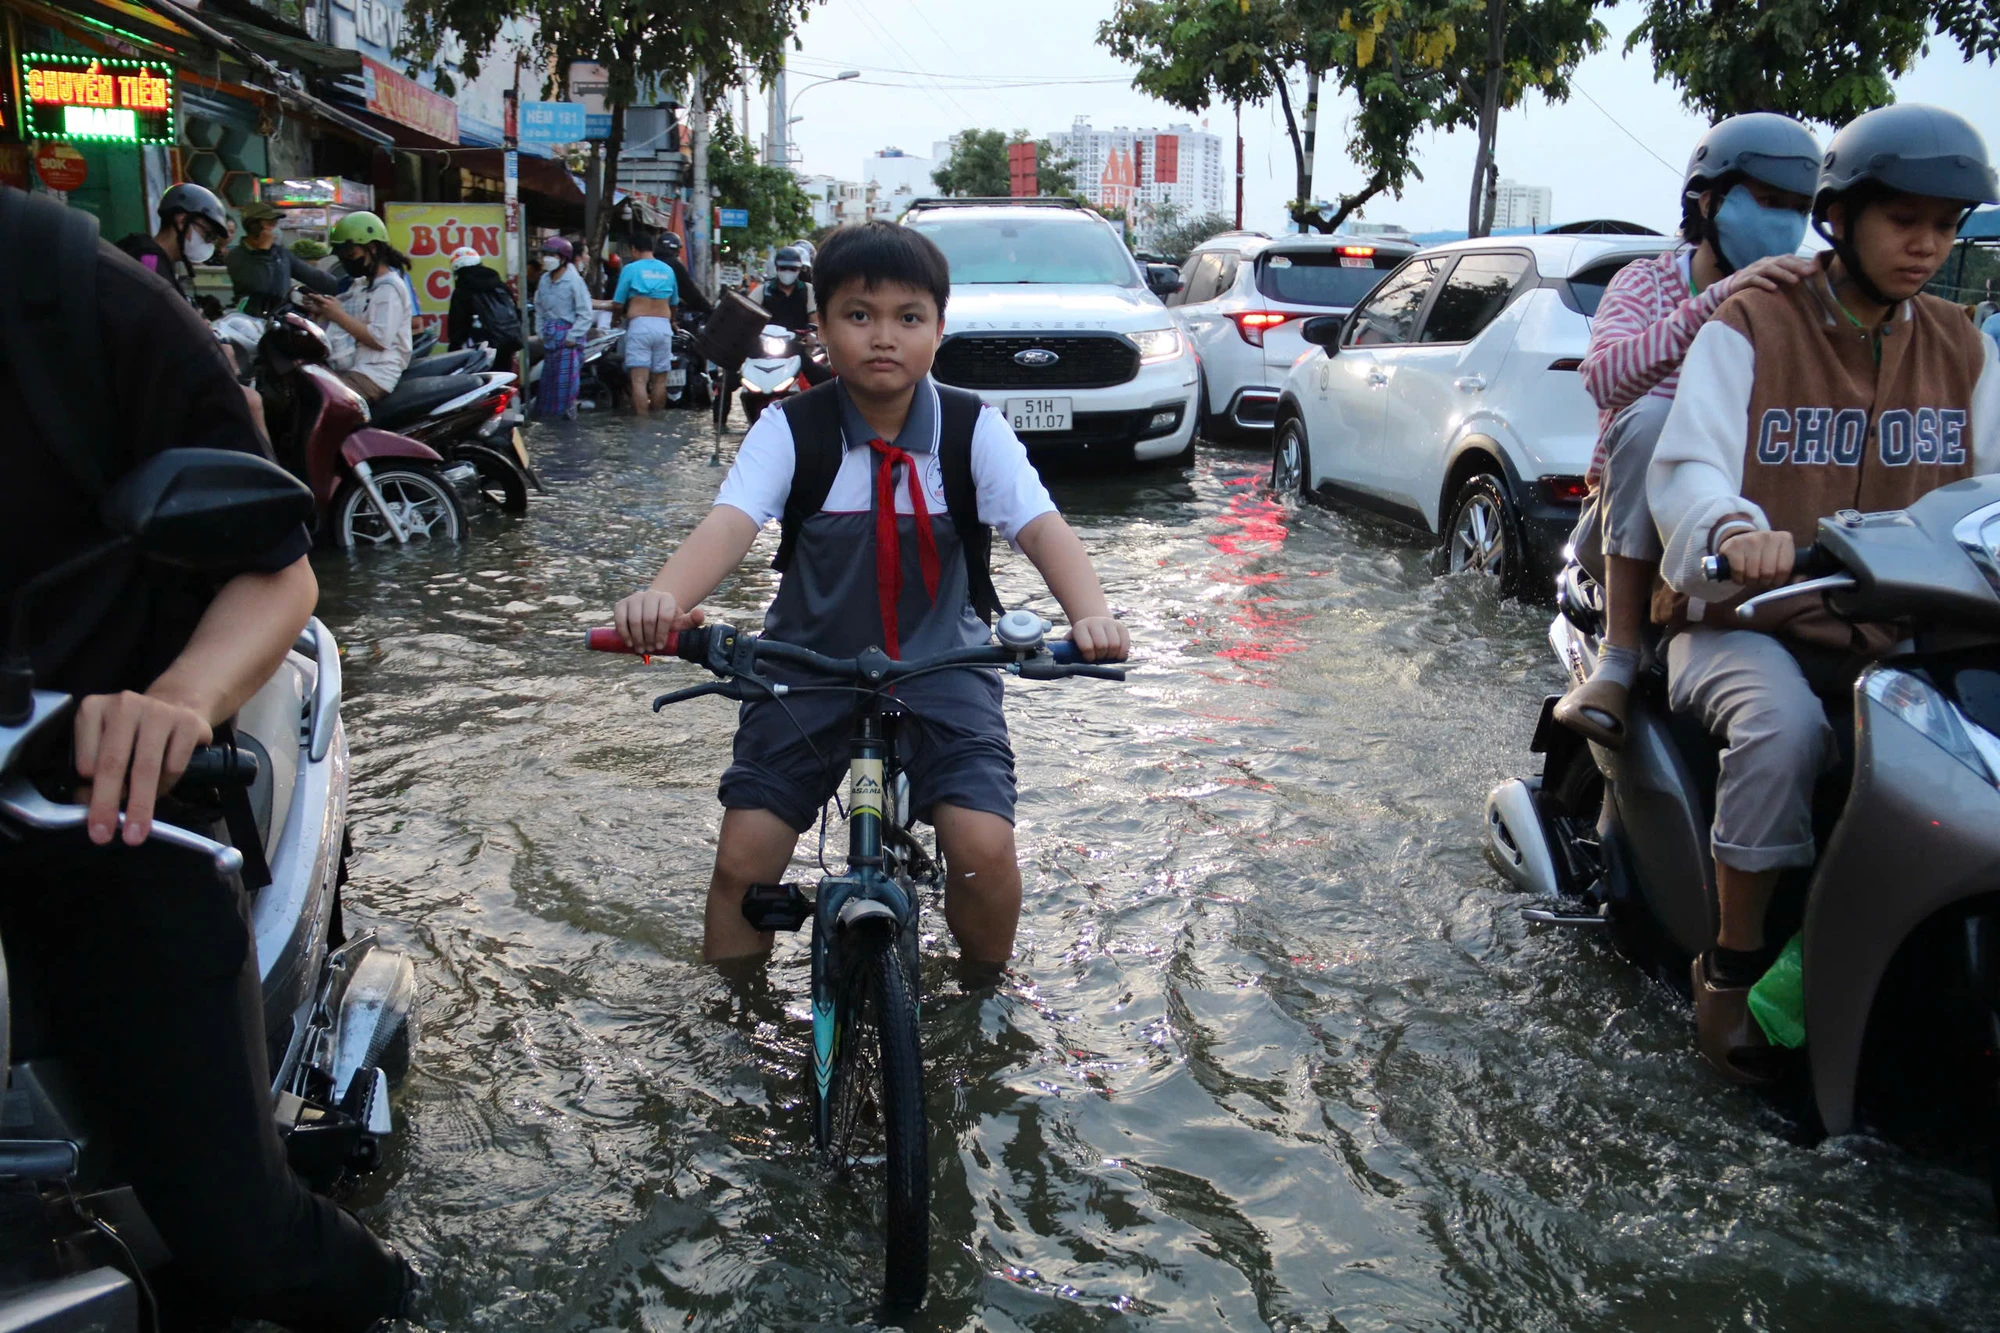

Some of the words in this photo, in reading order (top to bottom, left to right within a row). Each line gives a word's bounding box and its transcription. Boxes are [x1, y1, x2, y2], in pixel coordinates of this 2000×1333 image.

[28, 60, 114, 104] CHUYỂN
[408, 217, 501, 258] BÚN
[1022, 351, 1049, 364] Ford
[1025, 400, 1054, 414] 51H
[1013, 414, 1065, 429] 811.07
[851, 787, 881, 795] ASAMA
